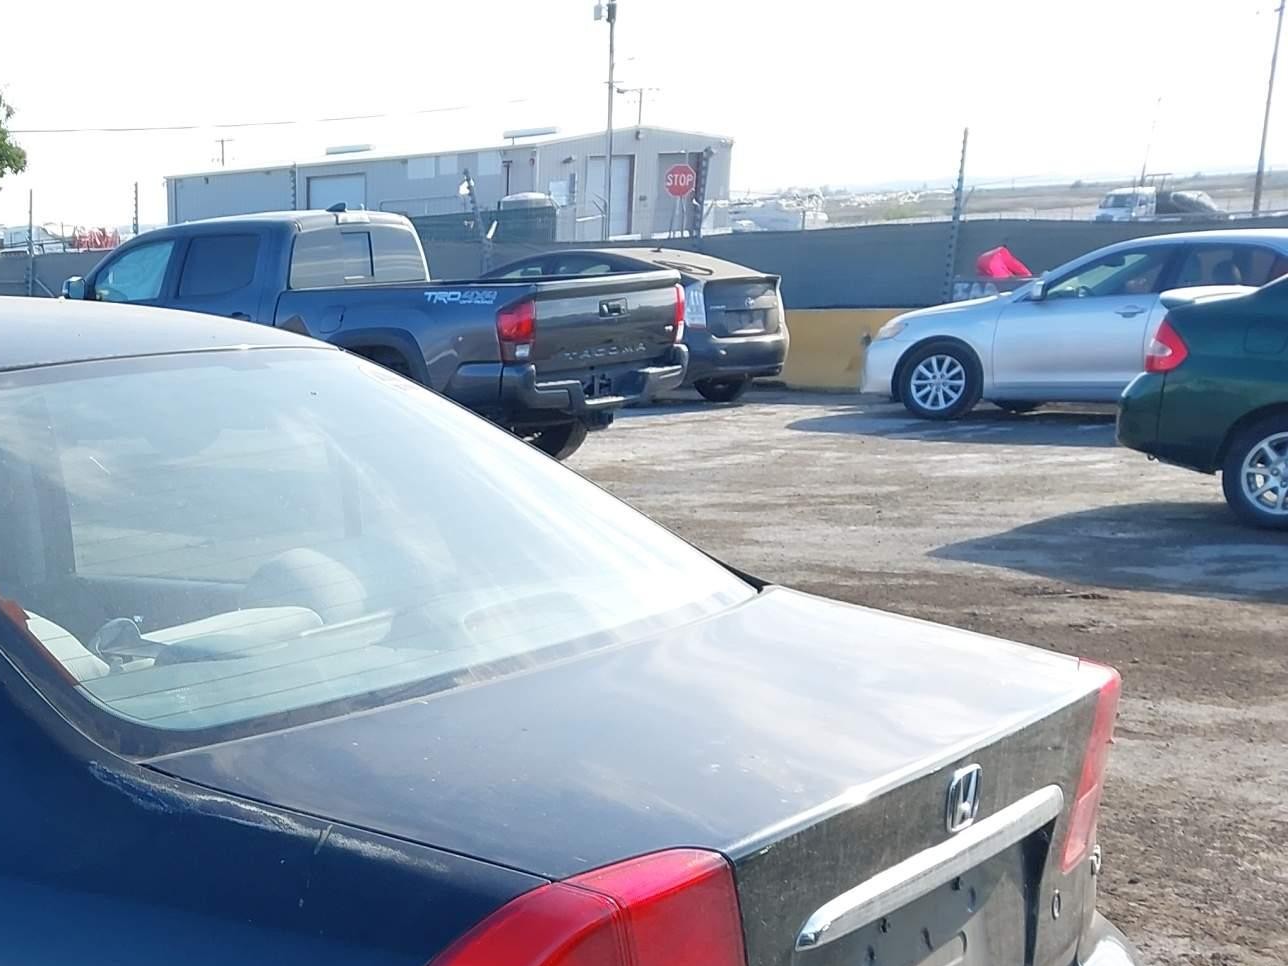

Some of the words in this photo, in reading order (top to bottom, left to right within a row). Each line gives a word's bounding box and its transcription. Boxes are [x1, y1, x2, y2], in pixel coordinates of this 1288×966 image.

[667, 174, 694, 186] STOP
[424, 291, 462, 304] TRD
[563, 343, 647, 361] TACOMA
